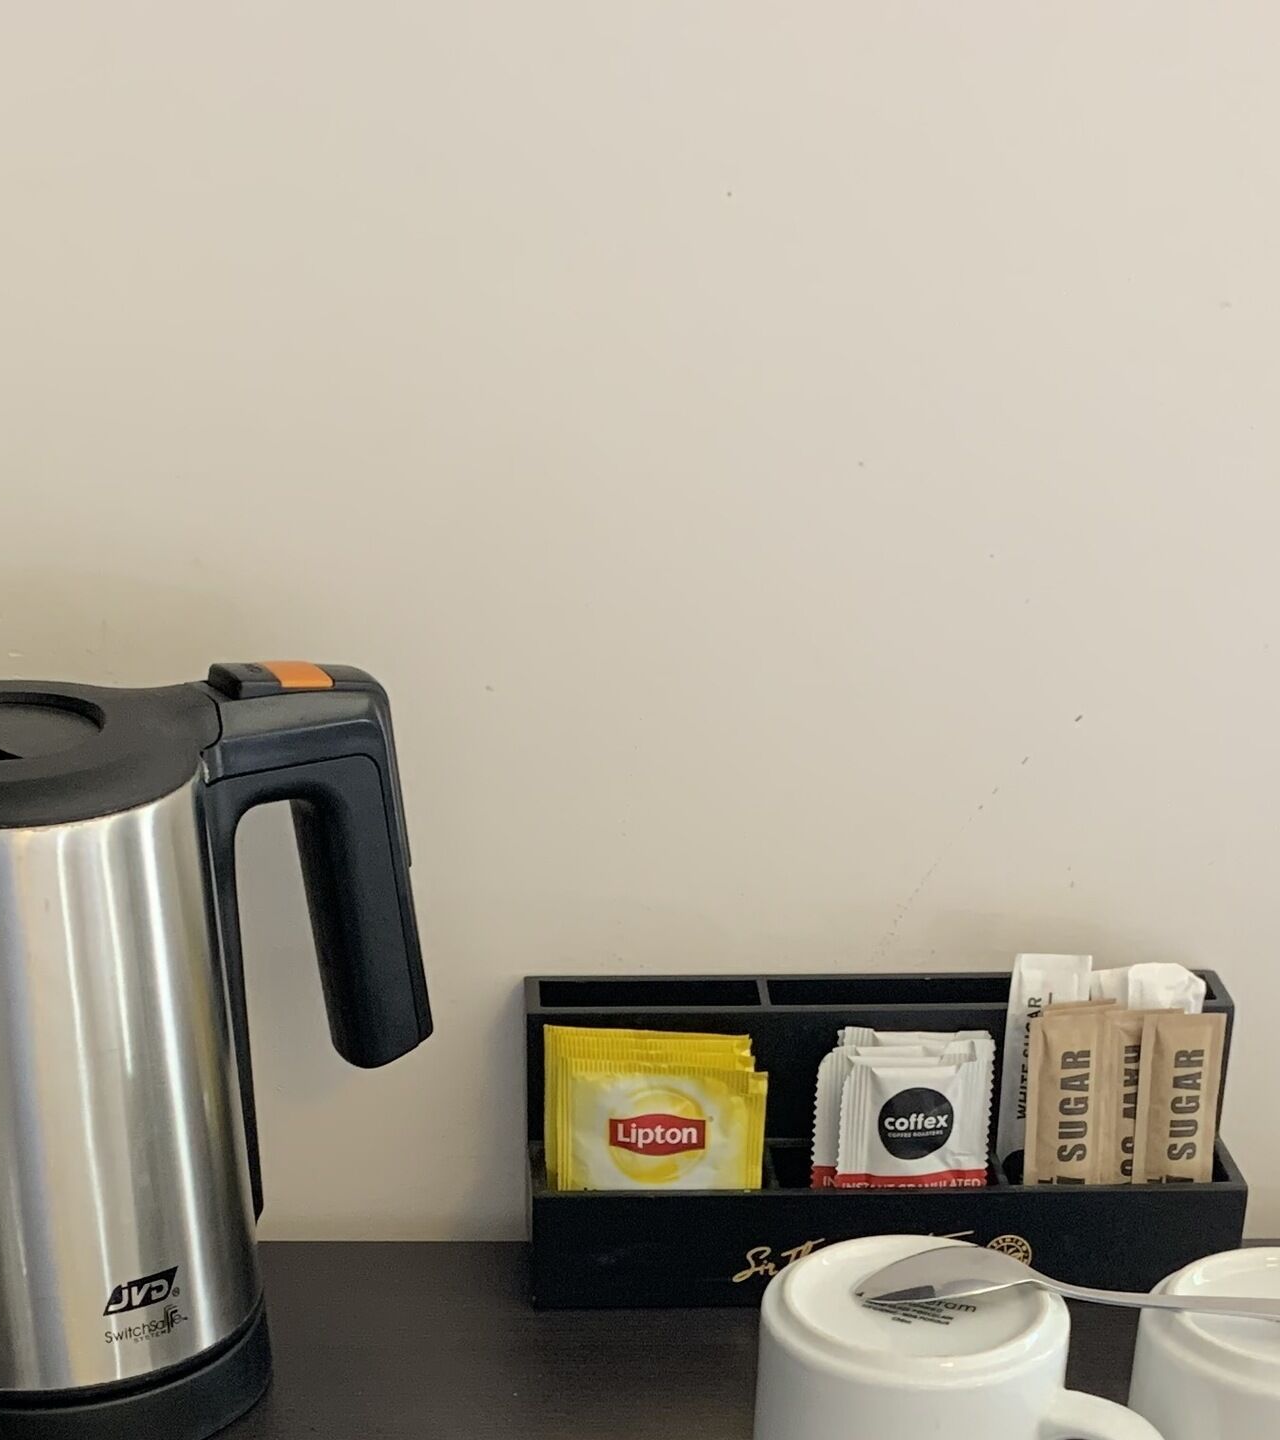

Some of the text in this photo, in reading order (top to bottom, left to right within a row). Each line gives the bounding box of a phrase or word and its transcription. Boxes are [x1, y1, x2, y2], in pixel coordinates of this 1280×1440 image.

[883, 1112, 949, 1132] coffex
[1057, 1049, 1091, 1163] SUGAR
[1167, 1049, 1205, 1161] SUGAR
[616, 1123, 698, 1149] Lipton
[106, 1275, 172, 1313] JVD
